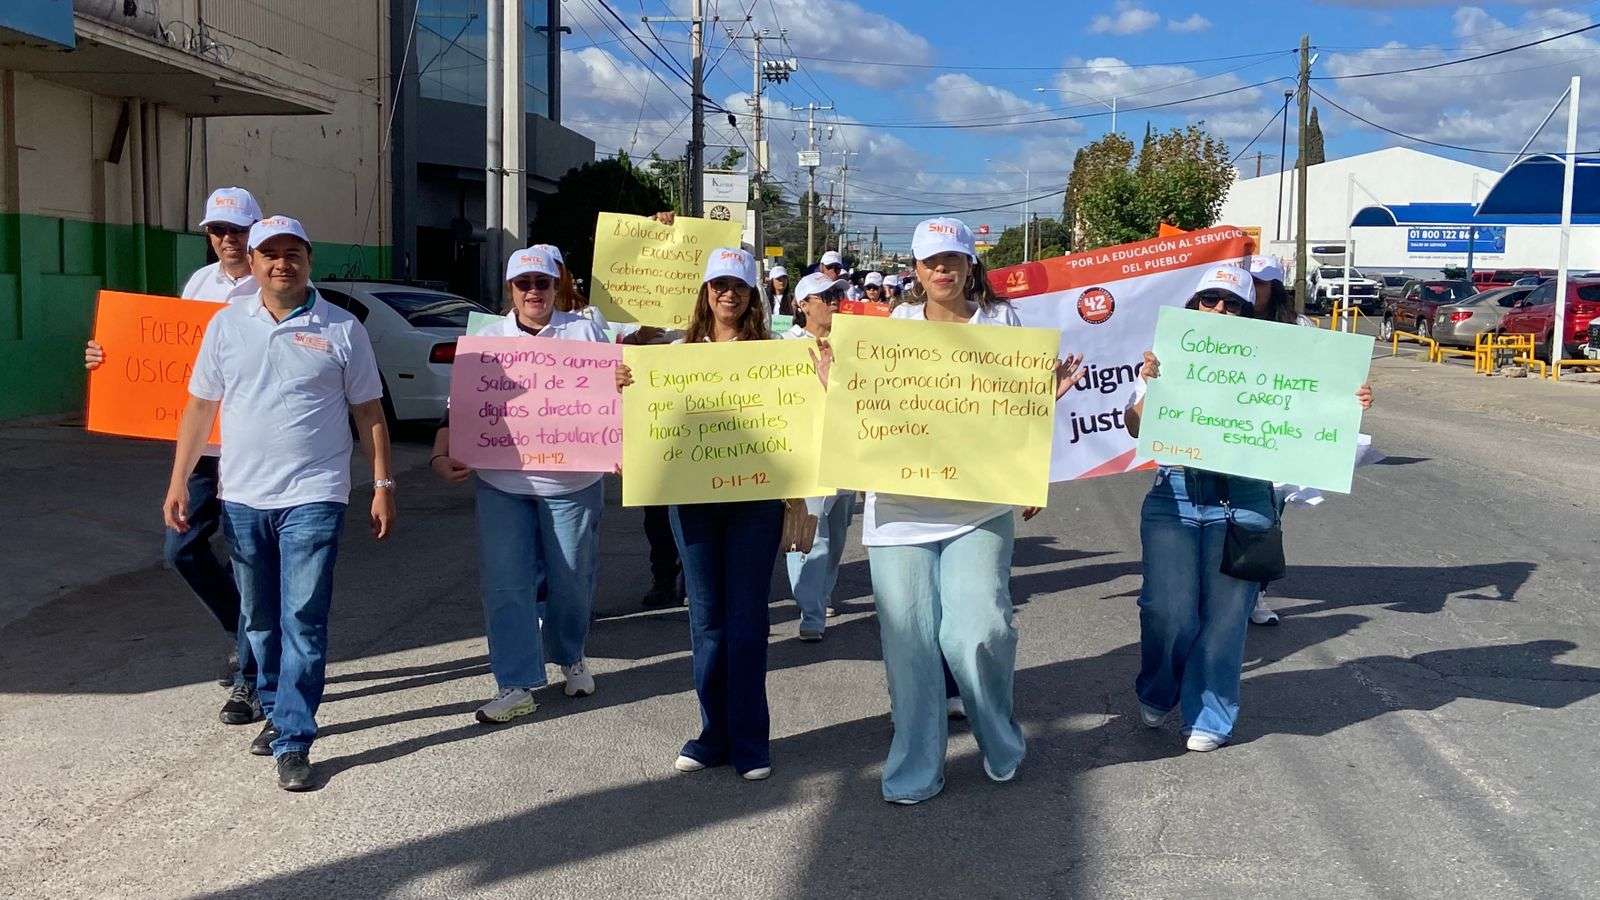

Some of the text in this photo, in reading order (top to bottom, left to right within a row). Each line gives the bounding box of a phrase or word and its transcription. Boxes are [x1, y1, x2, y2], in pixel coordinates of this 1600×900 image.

[928, 223, 956, 235] SNTE
[1410, 230, 1480, 240] 01 800 122 866
[682, 234, 699, 245] no
[1096, 252, 1111, 264] LA
[1111, 238, 1177, 262] EDUCACIÓN
[1178, 236, 1193, 249] AL
[1195, 228, 1243, 246] SERVICIO
[664, 268, 700, 281] cobren
[1006, 270, 1026, 286] 42
[1122, 262, 1143, 275] DEL
[1083, 294, 1107, 310] 42
[140, 315, 203, 346] FUERA
[1180, 328, 1258, 359] Gobierno:
[480, 350, 557, 370] Exigimos
[856, 339, 943, 373] Exigimos
[476, 373, 590, 393] Salarial de 2
[649, 369, 724, 393] Exigimos
[729, 373, 740, 382] a
[847, 372, 1054, 396] de promoción horizontal
[1256, 372, 1267, 386] O
[1273, 374, 1319, 393] HAZTE
[538, 397, 592, 417] directo
[598, 398, 617, 416] al
[648, 387, 806, 421] que Basifique las
[856, 393, 1050, 417] para educación Media
[649, 412, 788, 442] horas pendientes
[1158, 405, 1338, 443] por Pensiones Civiles del
[477, 431, 530, 448] Sueldo
[663, 446, 684, 462] de
